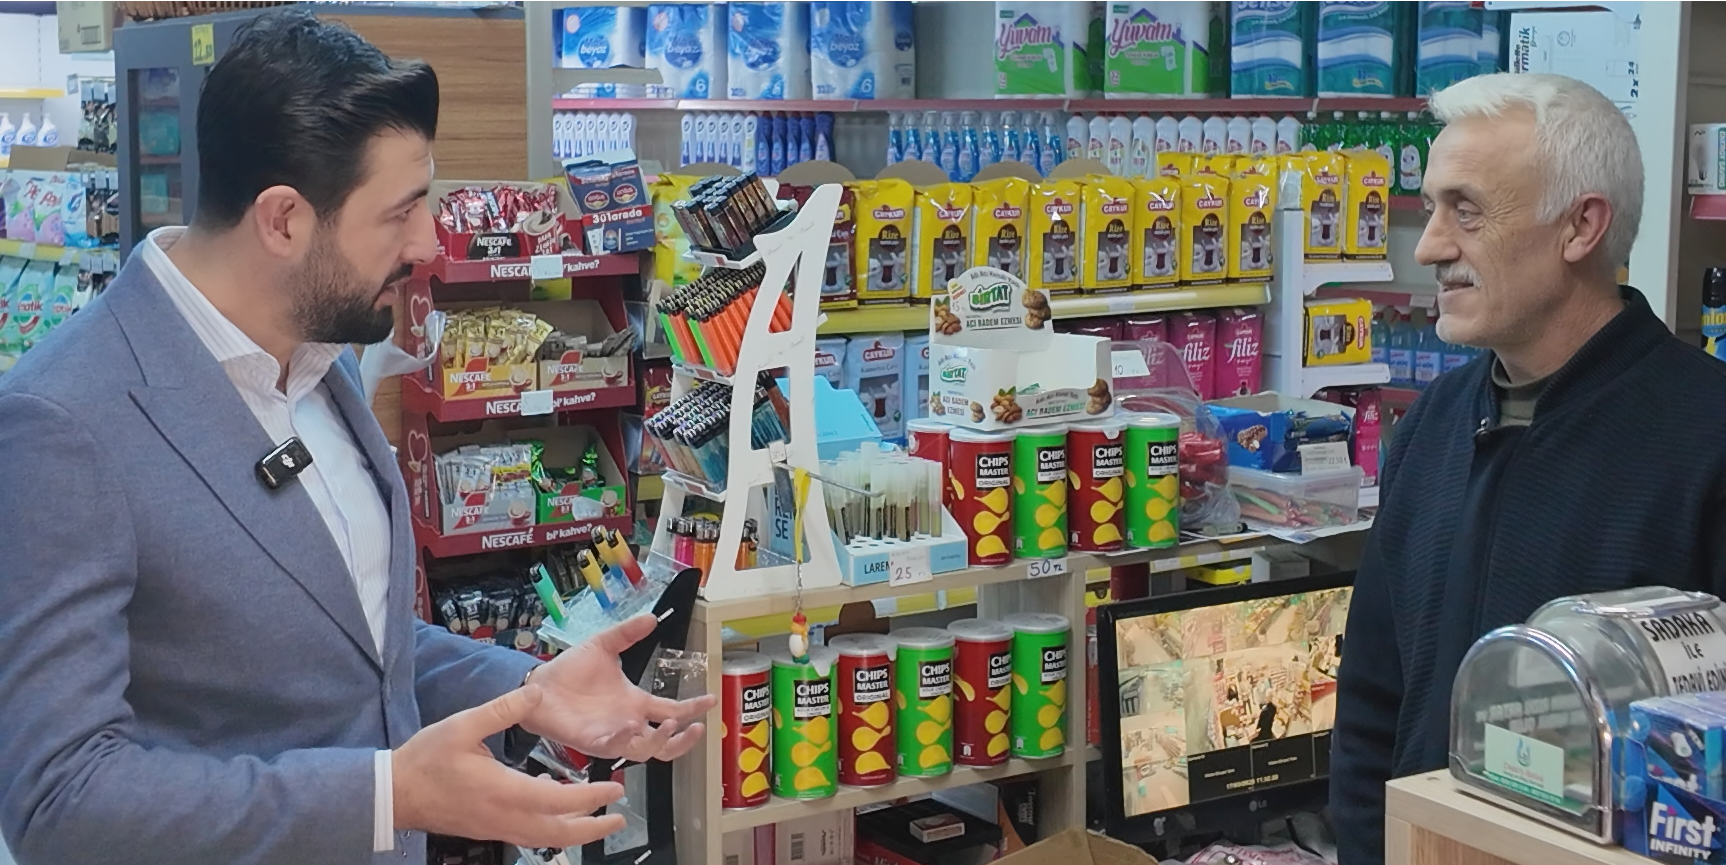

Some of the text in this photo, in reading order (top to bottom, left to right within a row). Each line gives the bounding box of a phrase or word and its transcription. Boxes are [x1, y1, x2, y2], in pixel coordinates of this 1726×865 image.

[999, 22, 1051, 60] Yuvam
[1108, 18, 1172, 57] Yuvam
[1519, 28, 1531, 73] rmatik
[695, 77, 706, 92] 6
[861, 78, 873, 93] 6
[490, 259, 600, 278] NESCA kahve?
[1184, 341, 1211, 363] filiz
[1227, 337, 1259, 364] filiz
[815, 356, 835, 365] YKUR
[1114, 364, 1124, 375] 10
[563, 391, 596, 406] kahve?
[1039, 449, 1065, 461] CHIPS
[1095, 446, 1123, 458] CHIPS
[1150, 444, 1177, 456] CHIPS
[978, 456, 1009, 468] CHIPS
[979, 467, 1009, 476] MASTER
[481, 527, 534, 549] NESCAFÉ
[559, 524, 592, 540] kahve?
[775, 518, 789, 540] SE
[895, 566, 912, 581] 25
[1029, 559, 1050, 576] 50
[1640, 611, 1716, 642] SADAKA
[855, 668, 888, 682] CHIPS
[921, 662, 950, 677] CHIPS
[796, 683, 829, 696] CHIPS
[856, 680, 888, 691] MASTER
[797, 694, 829, 705] MASTER
[1649, 801, 1717, 848] First
[1649, 840, 1712, 860] INFINITY
